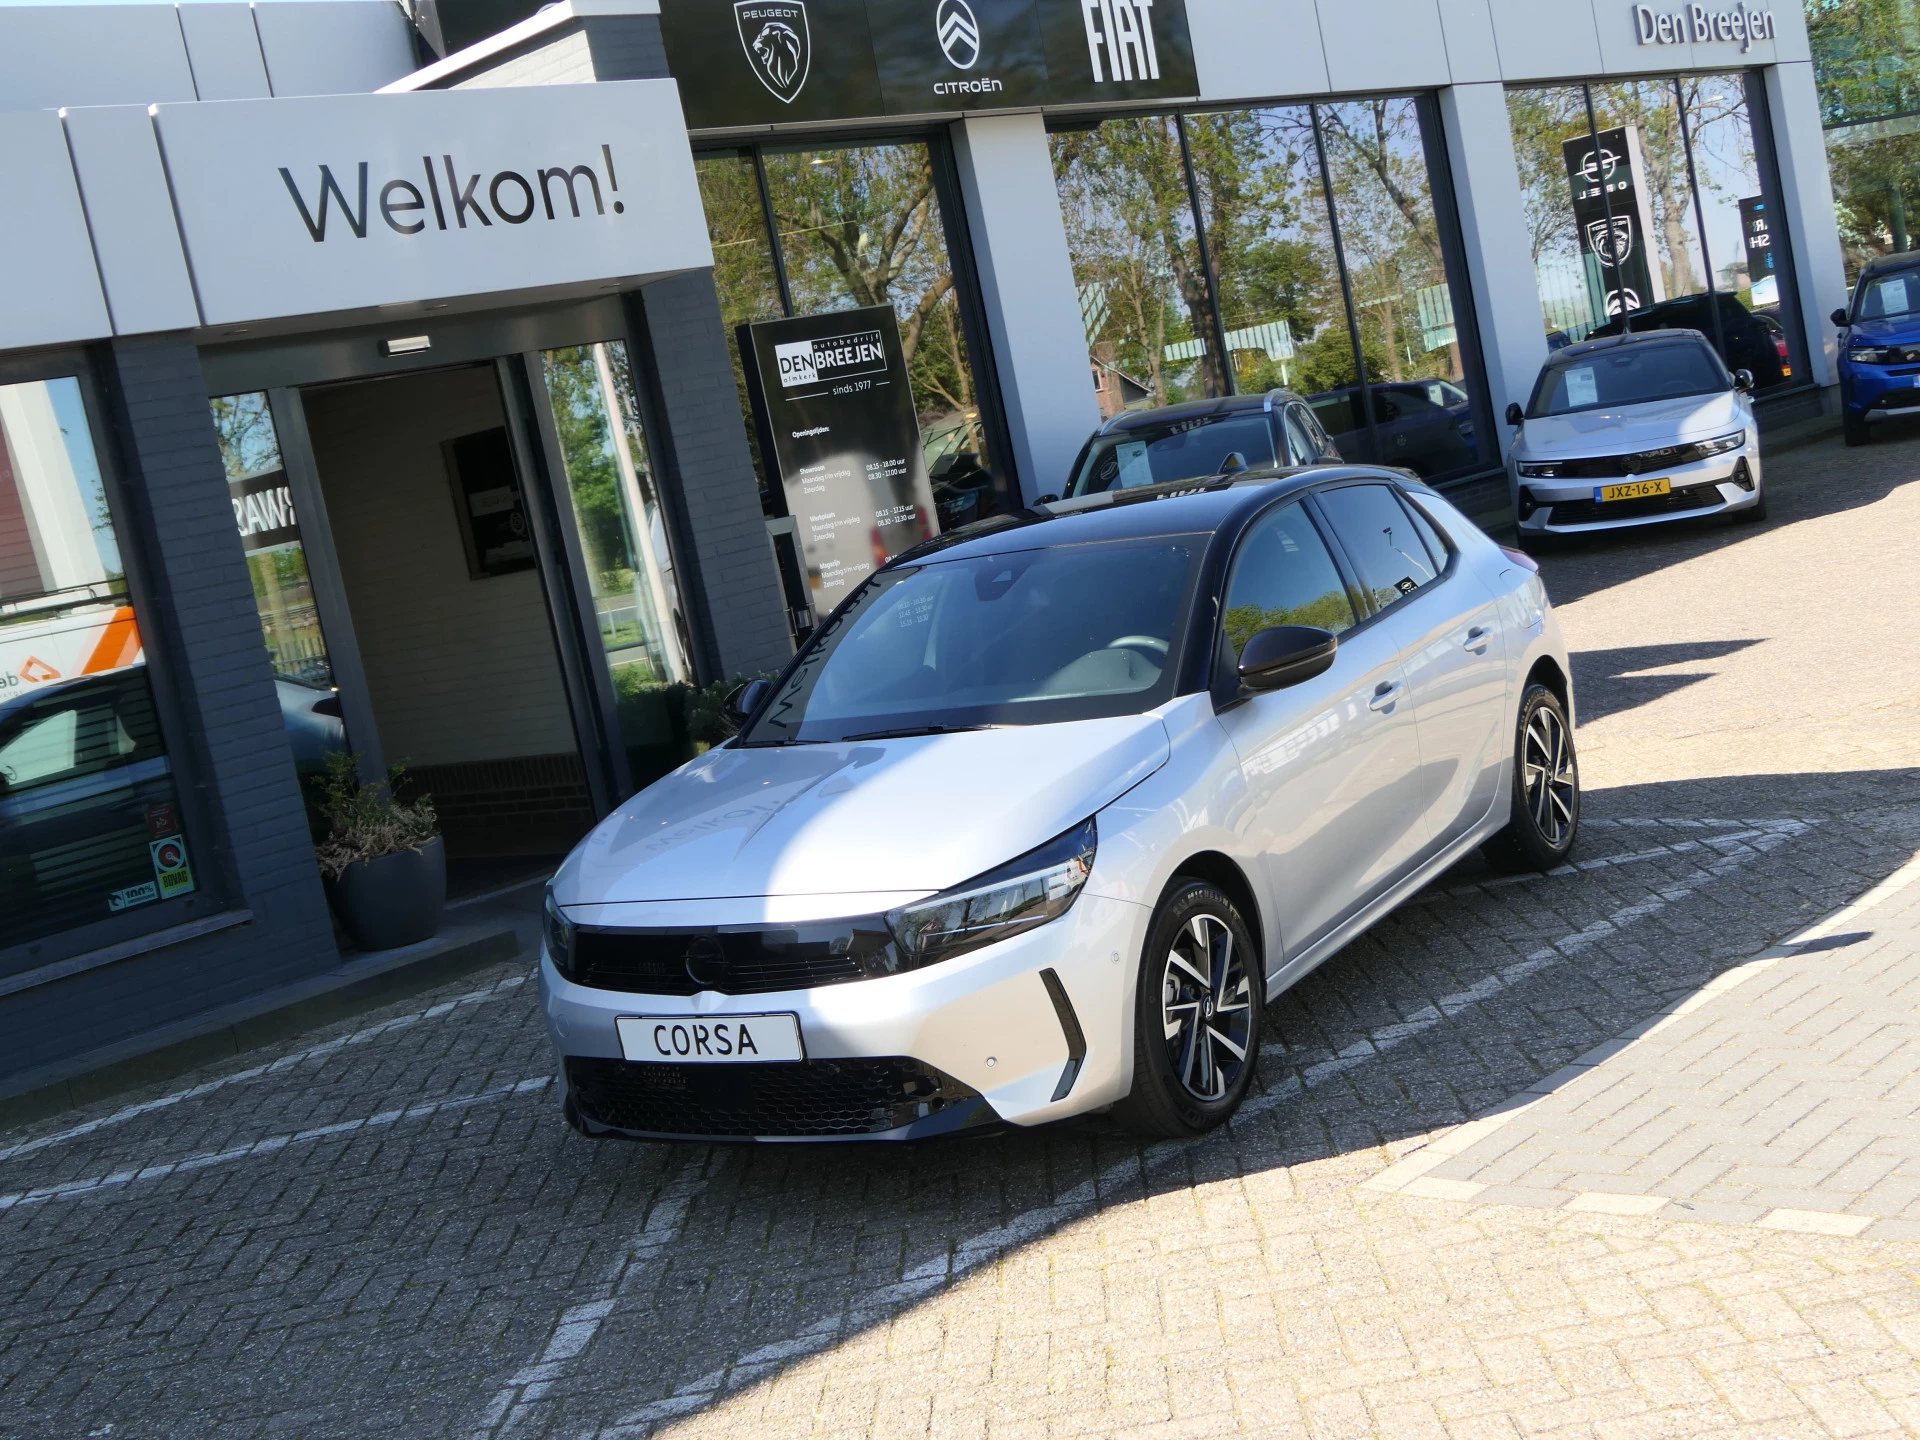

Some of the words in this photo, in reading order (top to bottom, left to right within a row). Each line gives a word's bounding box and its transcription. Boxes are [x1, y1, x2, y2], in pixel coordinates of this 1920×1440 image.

[742, 9, 798, 19] PEUGEOT
[1632, 4, 1688, 45] Den
[1686, 2, 1777, 54] Breejen
[1081, 0, 1160, 82] FIAT
[278, 144, 625, 242] Welkom!
[813, 333, 880, 350] autobedrijf
[780, 353, 815, 374] DEN
[815, 342, 883, 369] BREEJEN
[783, 372, 816, 383] almkerk
[832, 383, 853, 395] sinds
[854, 380, 871, 391] 1977
[800, 465, 825, 475] Showroom
[1609, 482, 1663, 498] JXZ-16-X
[162, 870, 188, 888] BOVAG
[653, 1023, 758, 1056] CORSA
